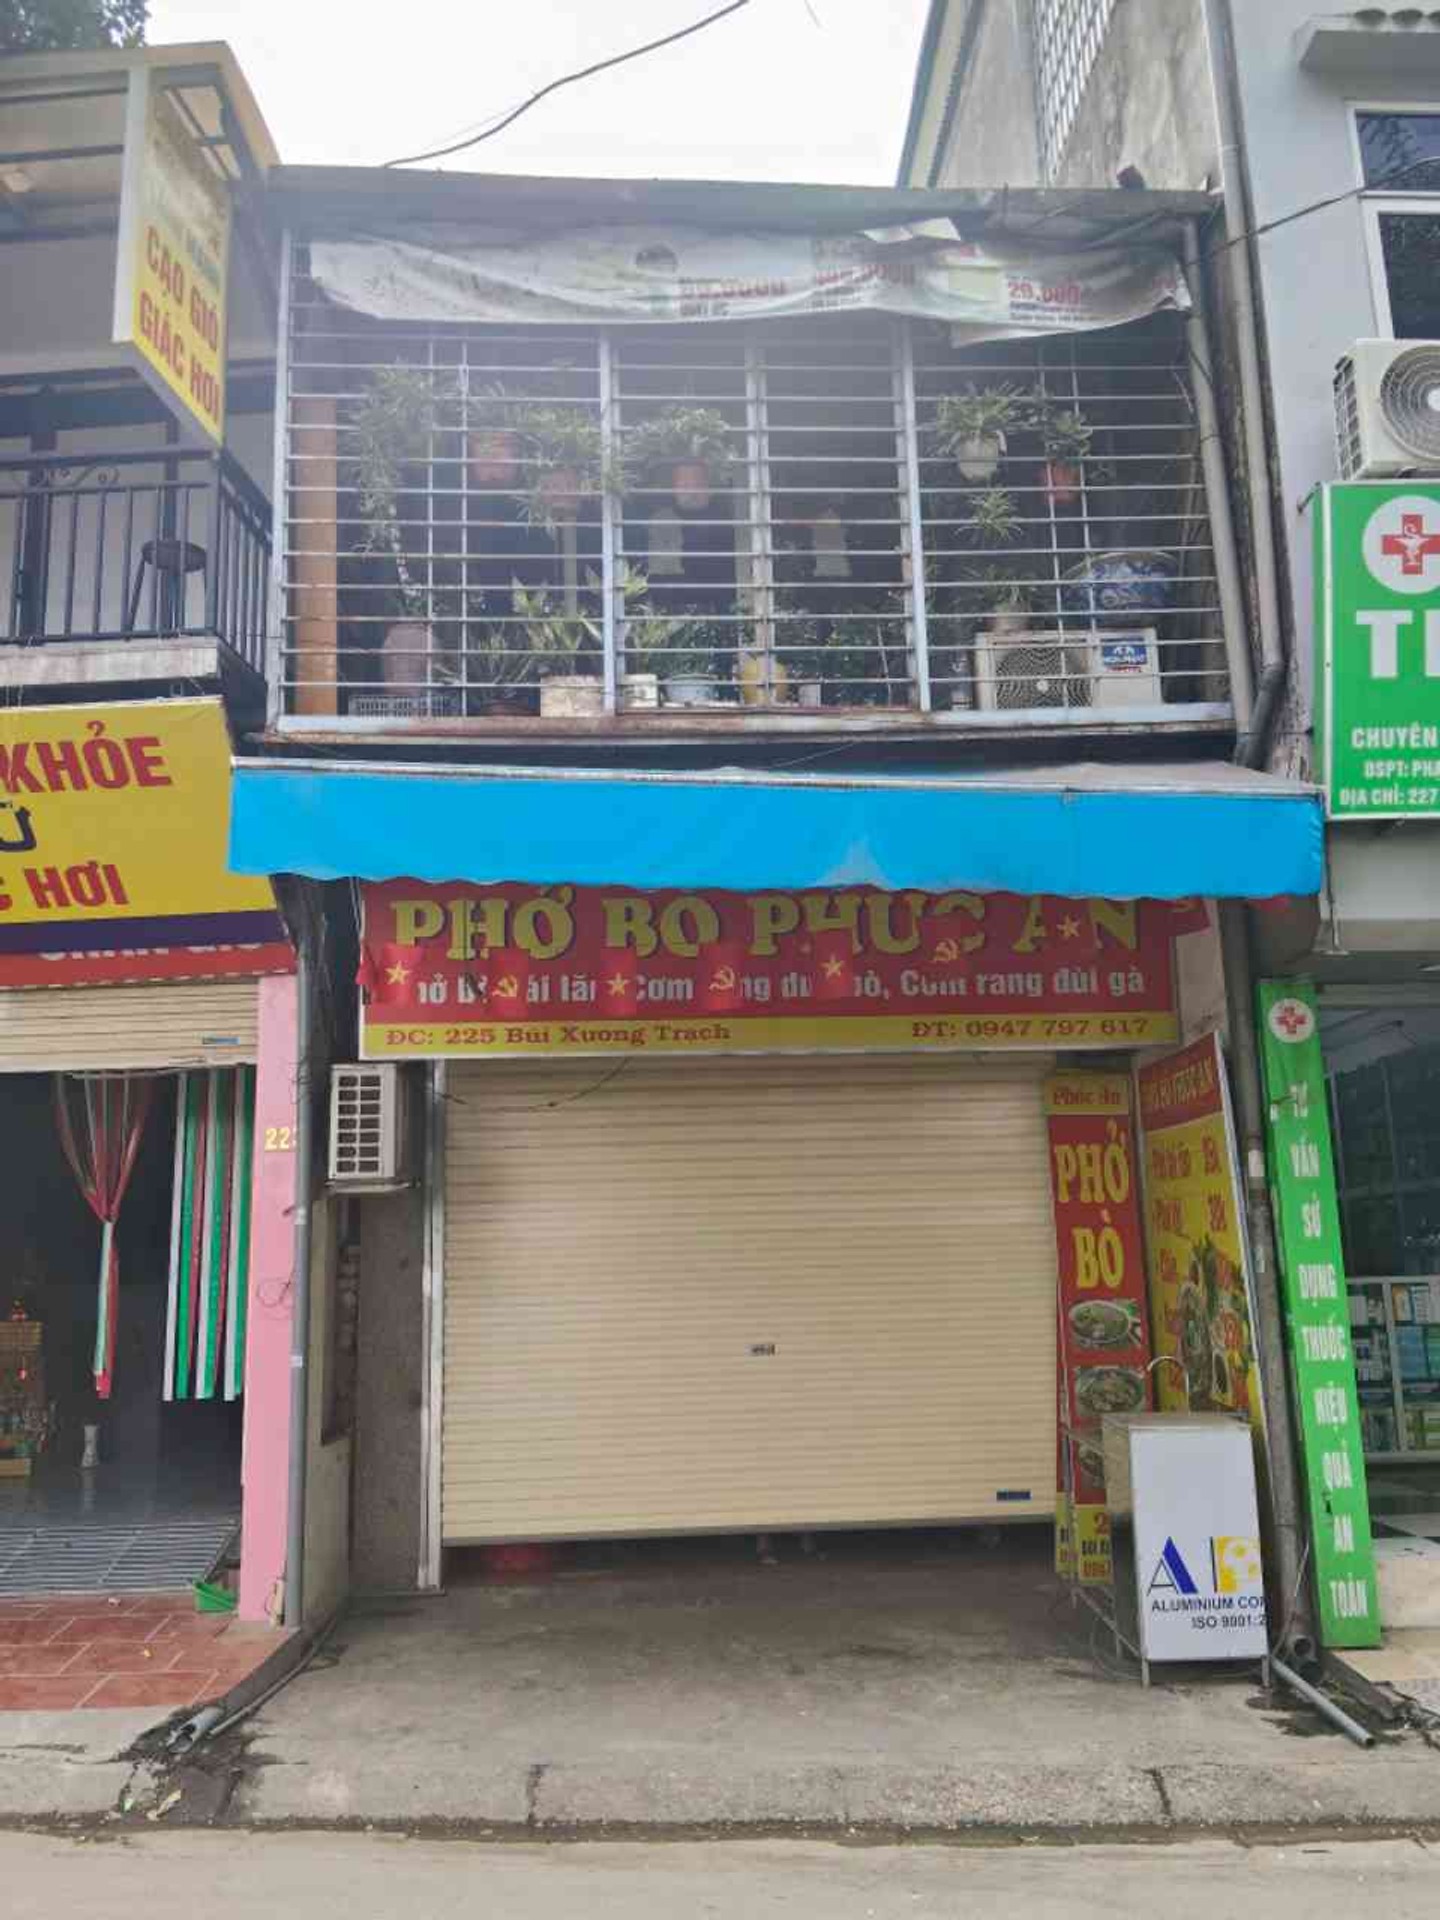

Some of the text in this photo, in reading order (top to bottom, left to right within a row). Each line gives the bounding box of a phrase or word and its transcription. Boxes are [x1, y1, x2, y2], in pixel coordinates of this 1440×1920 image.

[1351, 720, 1438, 749] CHUYÊN
[1408, 788, 1439, 806] 227
[24, 859, 129, 910] HƠI
[976, 971, 1043, 998] rang
[1108, 963, 1146, 998] gà
[445, 1027, 496, 1045] 225
[965, 1018, 1032, 1037] 0947
[1043, 1018, 1091, 1037] 797
[1101, 1017, 1149, 1036] 617
[264, 1126, 298, 1151] 22
[1054, 1117, 1131, 1204] PHỞ
[1071, 1207, 1126, 1289] BÒ
[1151, 1596, 1234, 1613] ALUMINIUM
[1191, 1615, 1218, 1630] ISO
